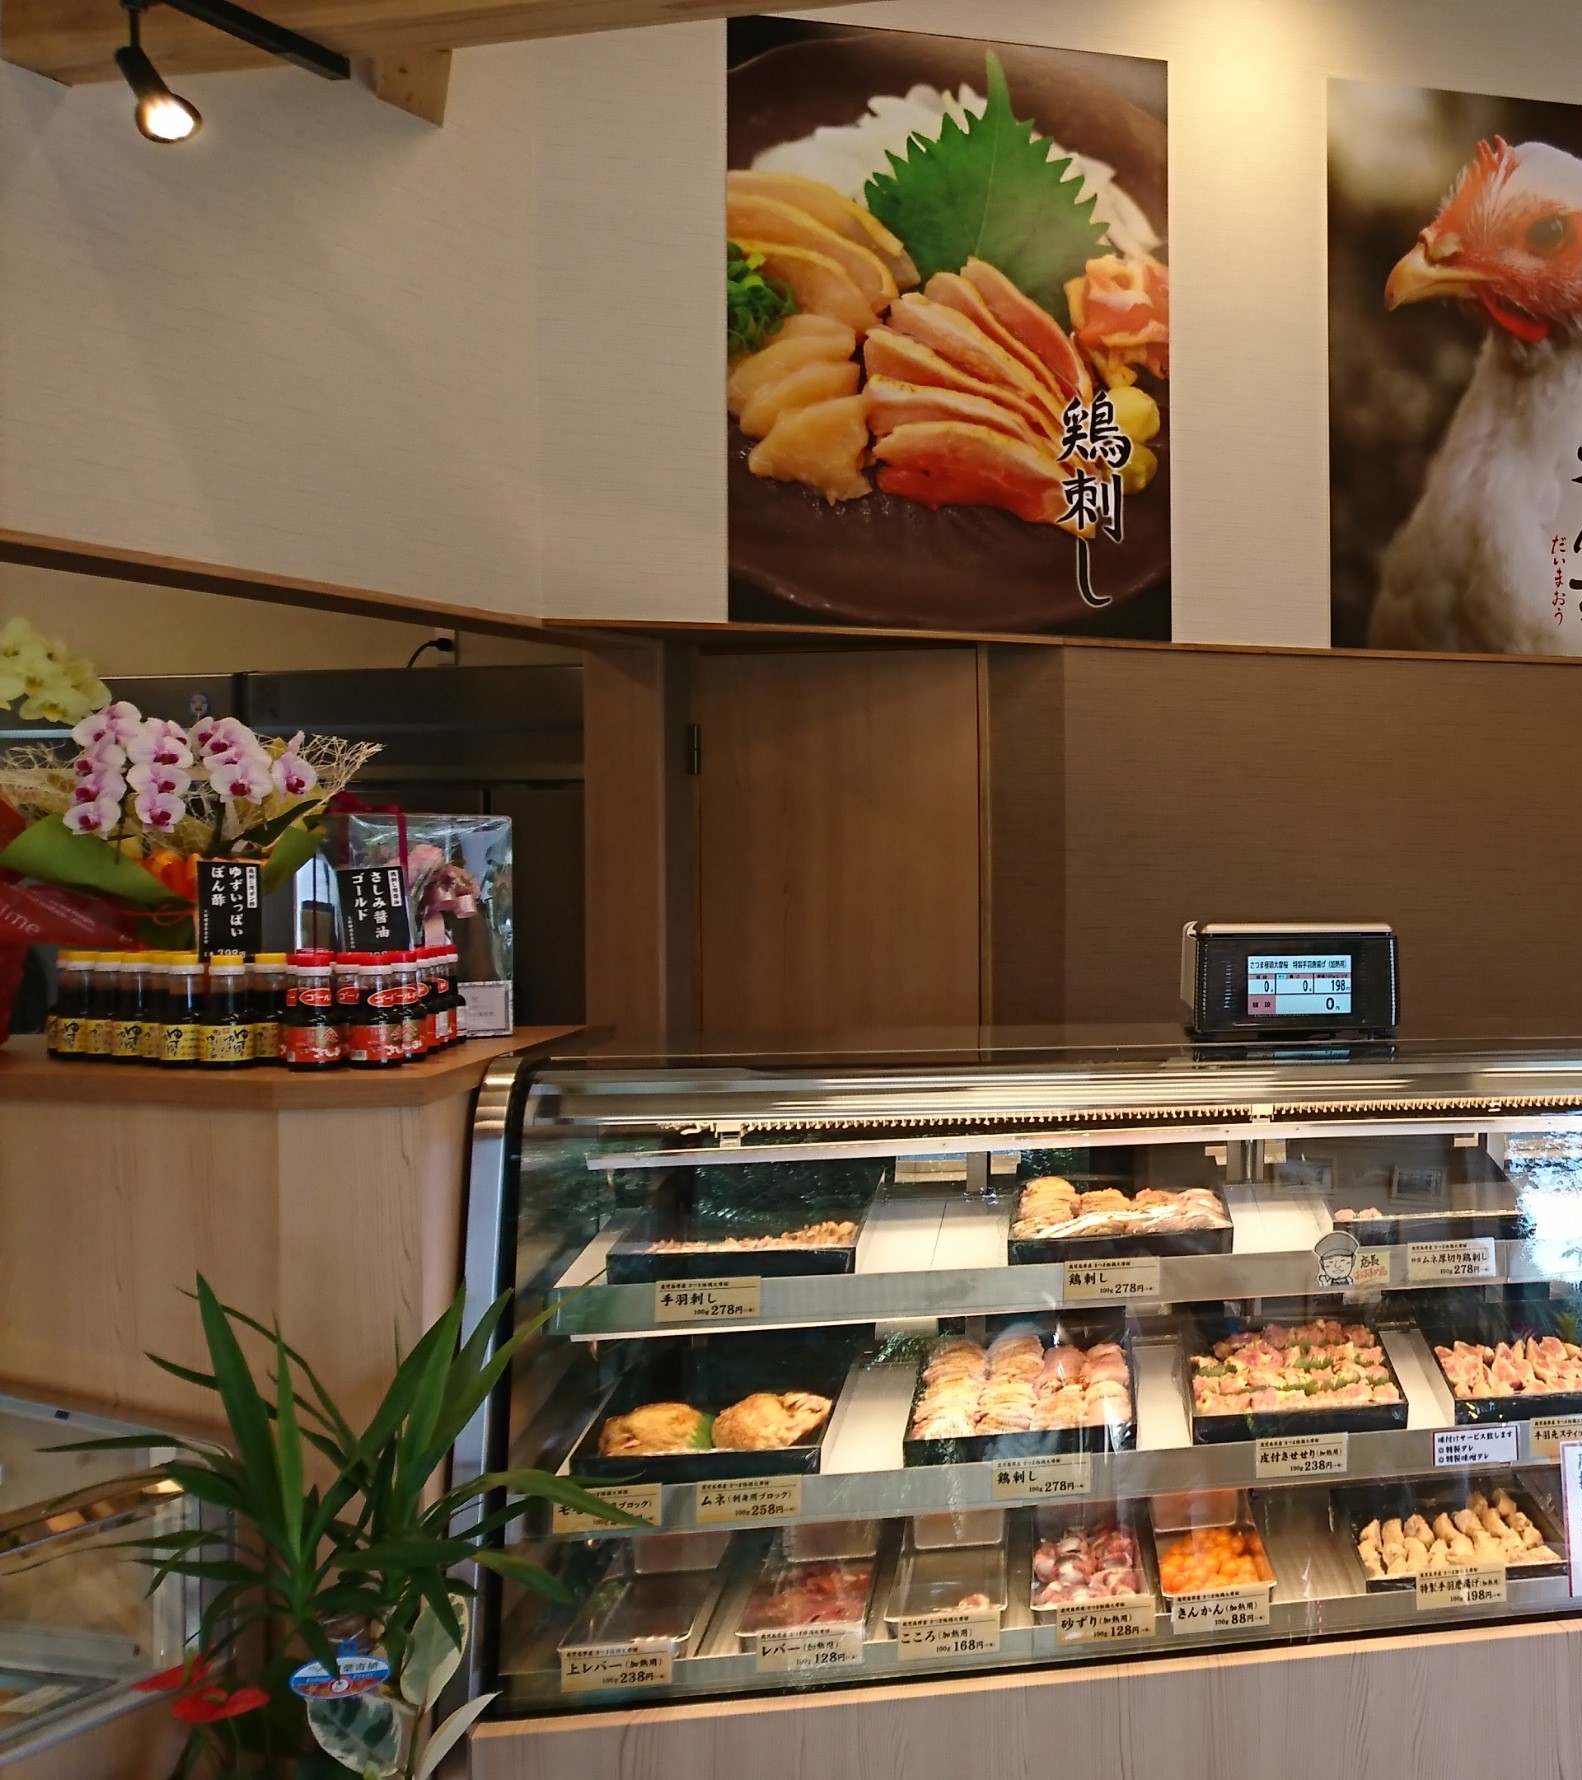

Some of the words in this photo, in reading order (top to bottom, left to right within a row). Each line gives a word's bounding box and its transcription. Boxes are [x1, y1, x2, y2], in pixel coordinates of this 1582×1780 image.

[1056, 390, 1132, 607] 鶏刺し
[1551, 535, 1567, 626] だいまおう
[352, 872, 368, 922] ゴールド
[370, 871, 390, 939] さしみ醤油
[660, 1292, 717, 1307] 手羽刺し
[1068, 1272, 1108, 1286] 鶏刺し
[997, 1470, 1038, 1485] 鶏刺し
